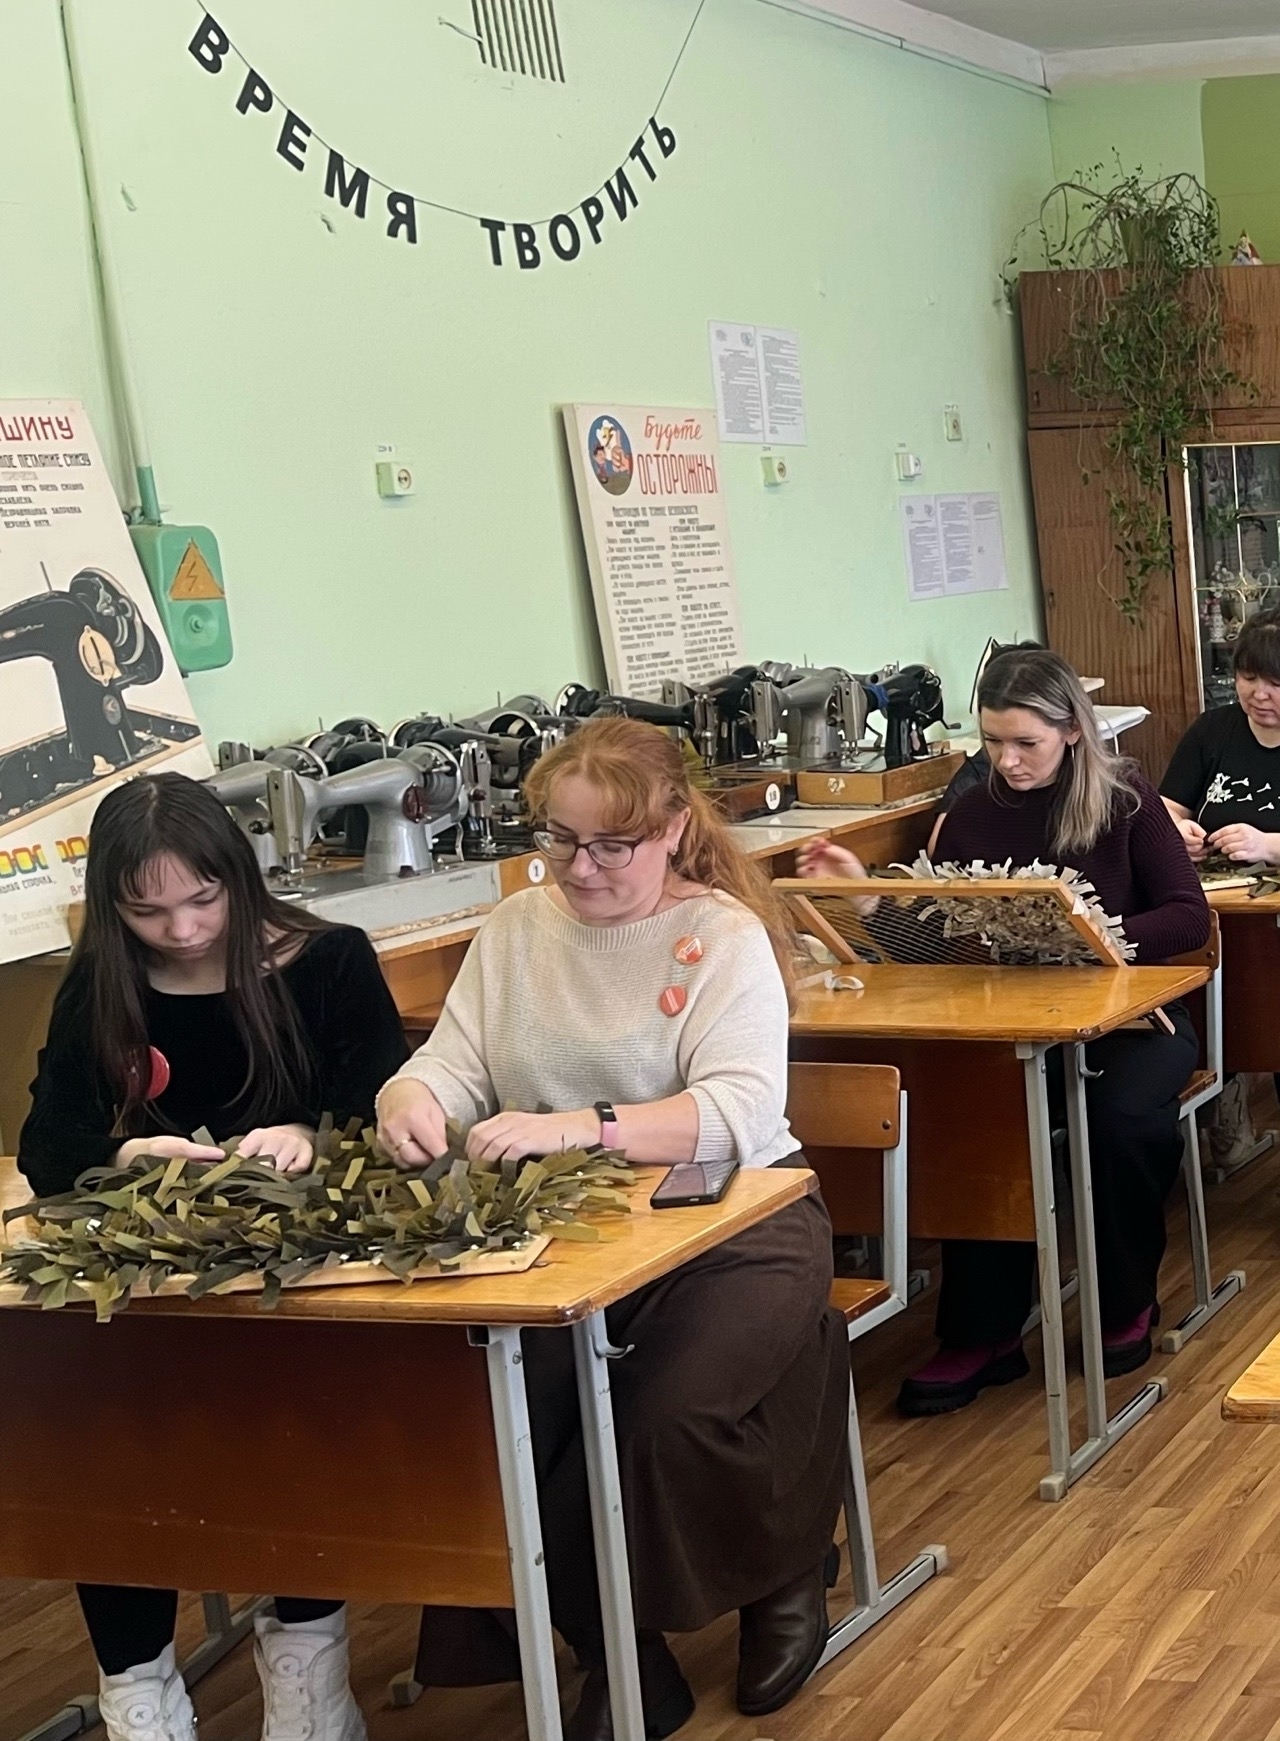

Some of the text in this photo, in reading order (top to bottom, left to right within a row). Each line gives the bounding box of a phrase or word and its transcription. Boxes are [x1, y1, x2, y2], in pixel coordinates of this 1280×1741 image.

[188, 13, 676, 270] ВРЕМЯ ТВОРИТЬ
[0, 416, 73, 441] ШИНУ
[644, 415, 703, 451] Будьте
[637, 453, 718, 495] ОСТОРОЖНЫ
[534, 865, 540, 877] 1
